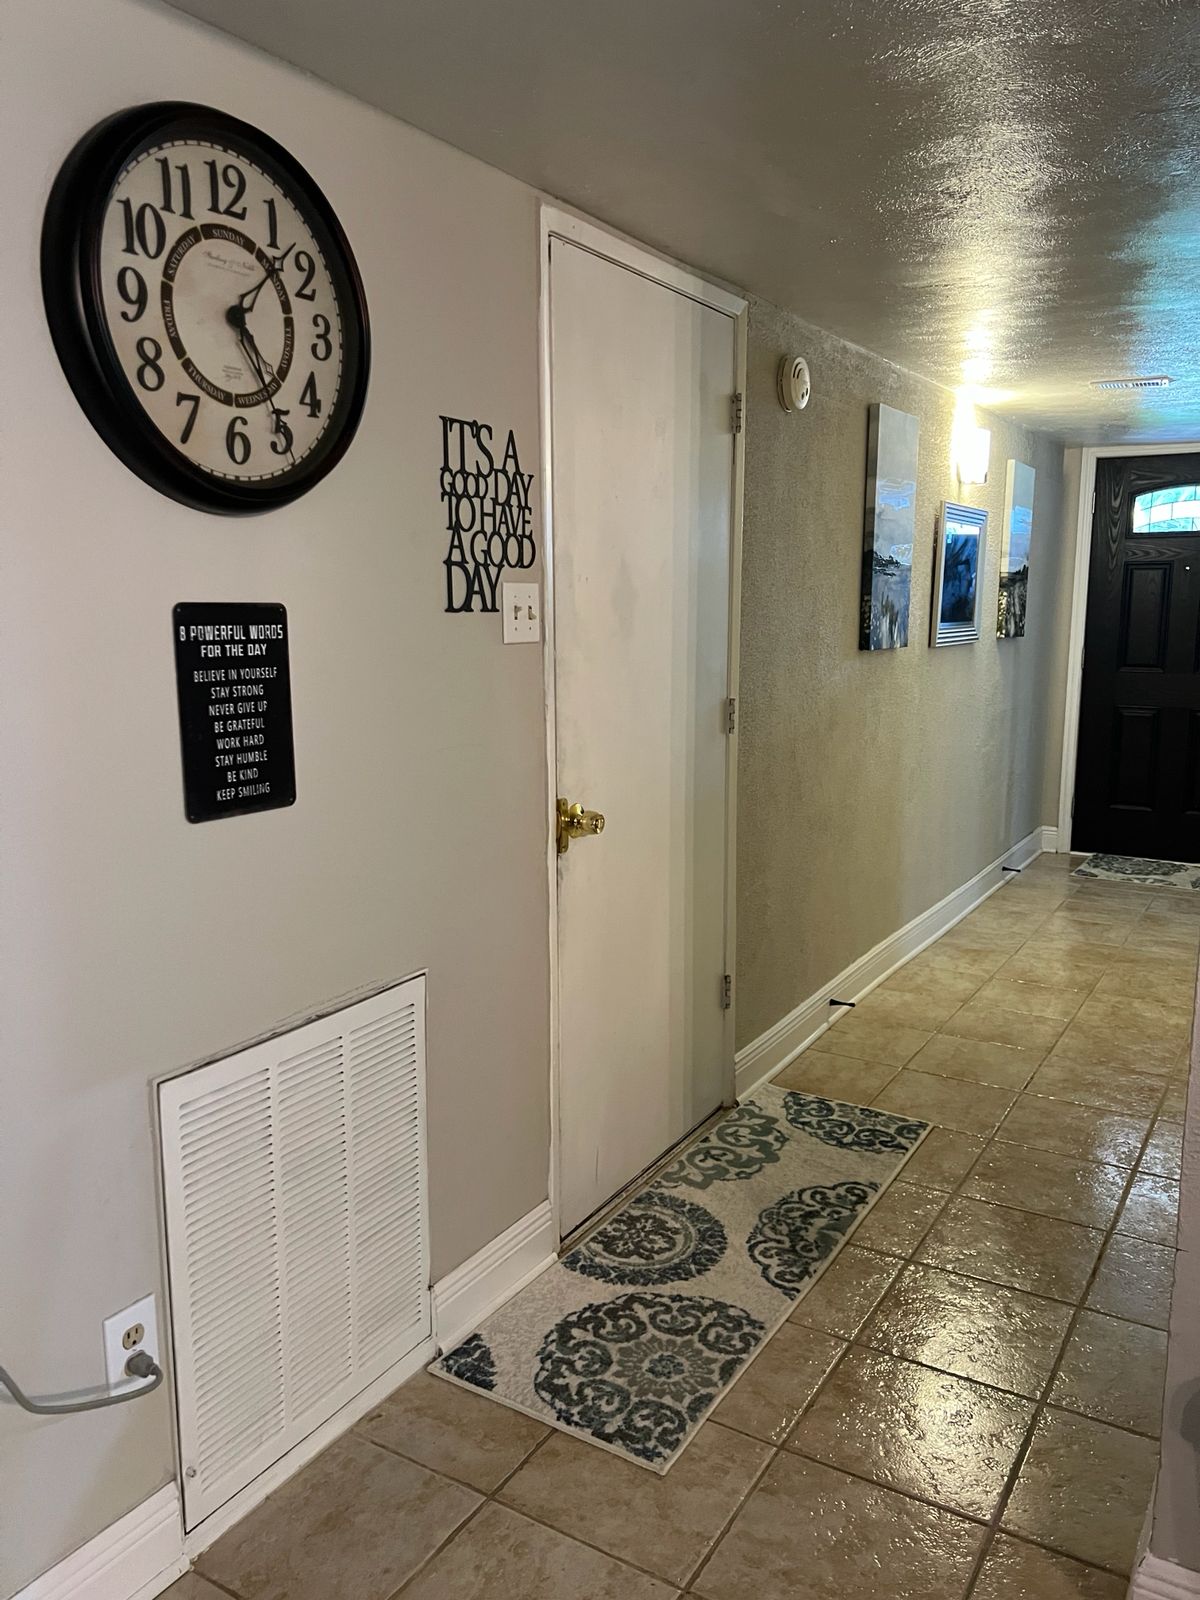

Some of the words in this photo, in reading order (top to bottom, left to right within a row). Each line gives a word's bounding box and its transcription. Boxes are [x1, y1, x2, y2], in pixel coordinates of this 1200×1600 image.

[156, 156, 195, 220] 11
[204, 160, 248, 220] 12
[117, 198, 166, 260] 10
[212, 229, 245, 246] SUNDAY
[264, 199, 280, 249] 1
[168, 234, 196, 276] SATURDAY
[295, 251, 317, 301] 2
[117, 267, 148, 322] 9
[164, 300, 178, 338] FRIDAY
[312, 314, 332, 361] 3
[137, 337, 165, 391] 8
[281, 327, 292, 369] TUESDAY
[188, 365, 226, 400] THURSDAY
[300, 371, 322, 418] 4
[176, 392, 200, 444] 7
[270, 409, 294, 455] 5
[226, 417, 251, 465] 6
[439, 415, 493, 478] IT'S
[502, 430, 522, 475] A
[440, 469, 488, 500] GOOD
[493, 469, 534, 508] DAY
[441, 492, 476, 532] TO
[480, 497, 532, 537] HAVE
[443, 522, 469, 565] A
[470, 530, 536, 568] GOOD
[444, 562, 504, 613] DAY
[179, 626, 186, 641] 8
[190, 625, 246, 641] POWERFUL
[249, 624, 284, 640] WORDS
[201, 645, 222, 658] FOR
[225, 644, 244, 656] THE
[247, 643, 267, 656] DAY
[193, 669, 226, 682] BELIEVE
[228, 668, 238, 680] IN
[240, 666, 277, 680] YOURSELF
[211, 686, 230, 699] STAY
[232, 684, 264, 698] STRONG
[208, 703, 235, 716] NEVER
[237, 702, 256, 714] GIVE
[214, 721, 224, 733] BE
[226, 717, 265, 732] GRATEFUL
[215, 754, 234, 767] STAY
[236, 750, 268, 764] HUMBLE
[216, 737, 241, 750] WORK
[243, 734, 265, 747] HARD
[216, 786, 236, 801] KEEP
[238, 782, 270, 798] SMILING
[227, 770, 237, 783] BE
[239, 767, 259, 780] KIND
